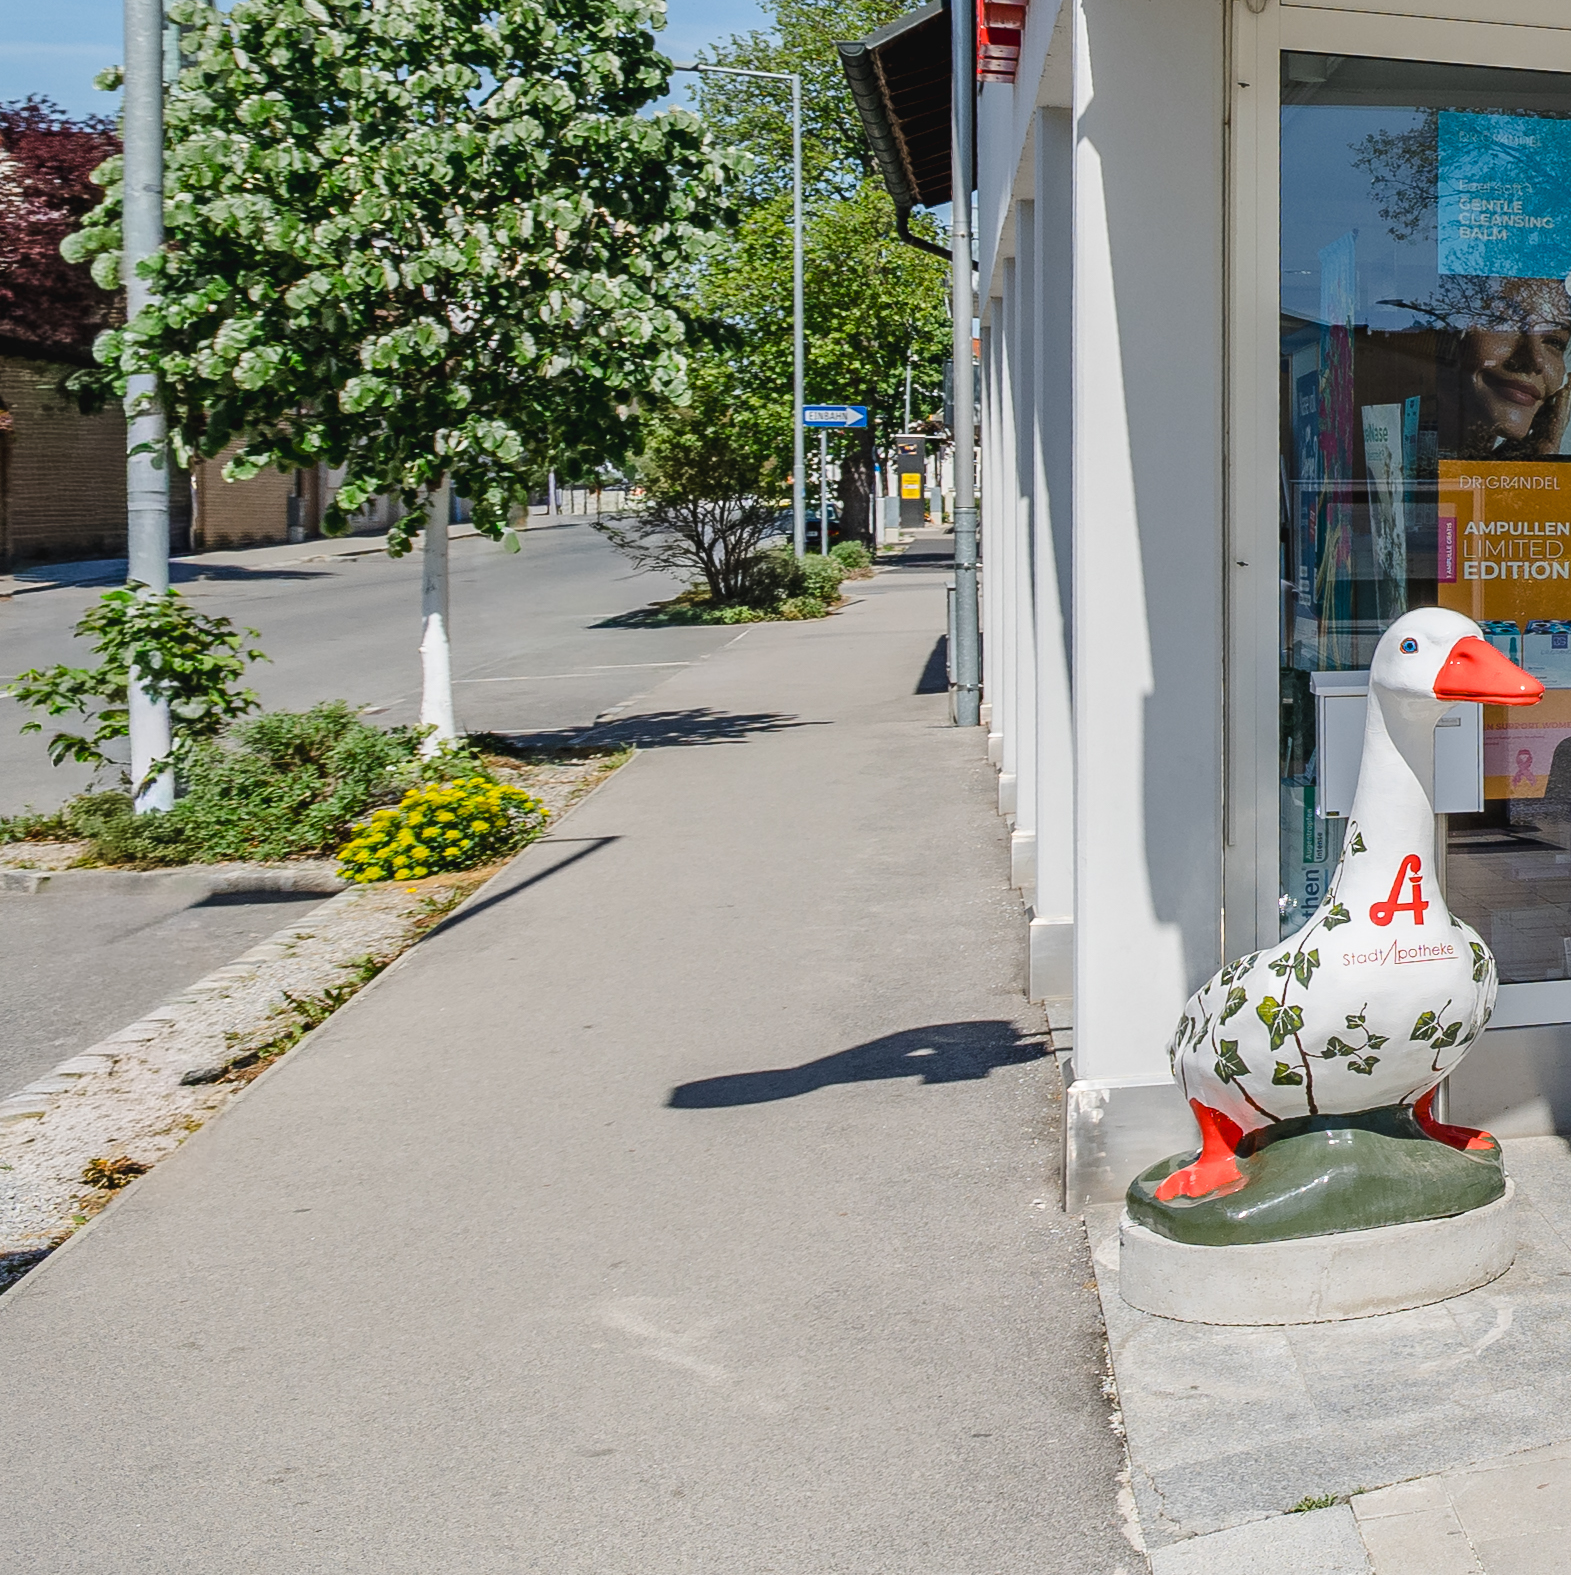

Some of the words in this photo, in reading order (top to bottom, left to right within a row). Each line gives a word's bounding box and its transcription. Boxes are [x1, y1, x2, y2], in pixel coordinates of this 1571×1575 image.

[1459, 198, 1523, 213] GENTLE
[1458, 212, 1555, 229] CLEANSING
[1459, 227, 1508, 241] BALM
[808, 411, 849, 421] EINBAHN
[1459, 475, 1560, 490] DR.GRANDEL
[1463, 521, 1570, 536] AMPULLEN
[1463, 539, 1564, 559] LIMITED
[1463, 561, 1570, 580] EDITION
[1305, 808, 1314, 860] Augentropfen
